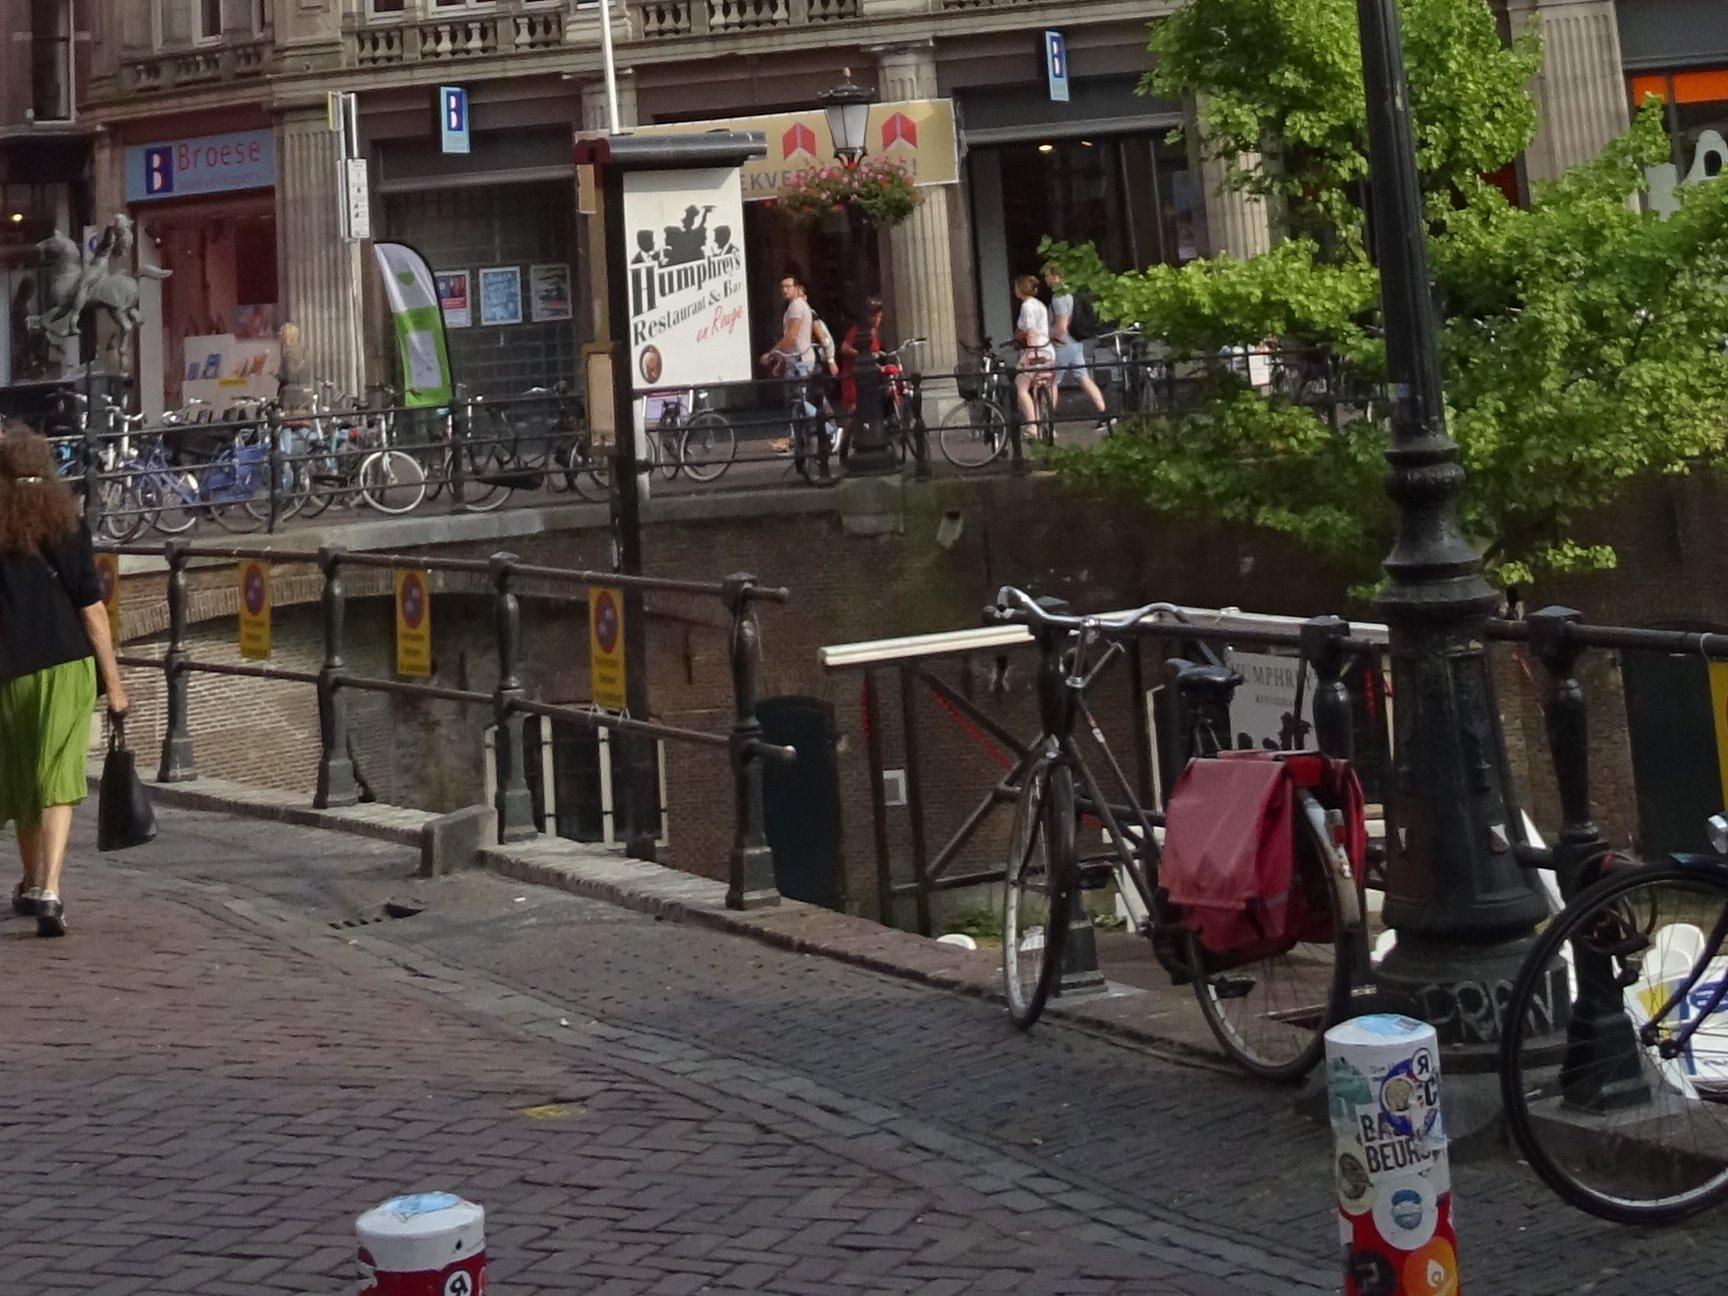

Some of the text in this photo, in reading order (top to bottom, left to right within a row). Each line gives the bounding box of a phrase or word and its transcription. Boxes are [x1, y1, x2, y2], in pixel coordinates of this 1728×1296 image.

[177, 142, 260, 171] Broese
[632, 280, 743, 348] Restaurant & Bar
